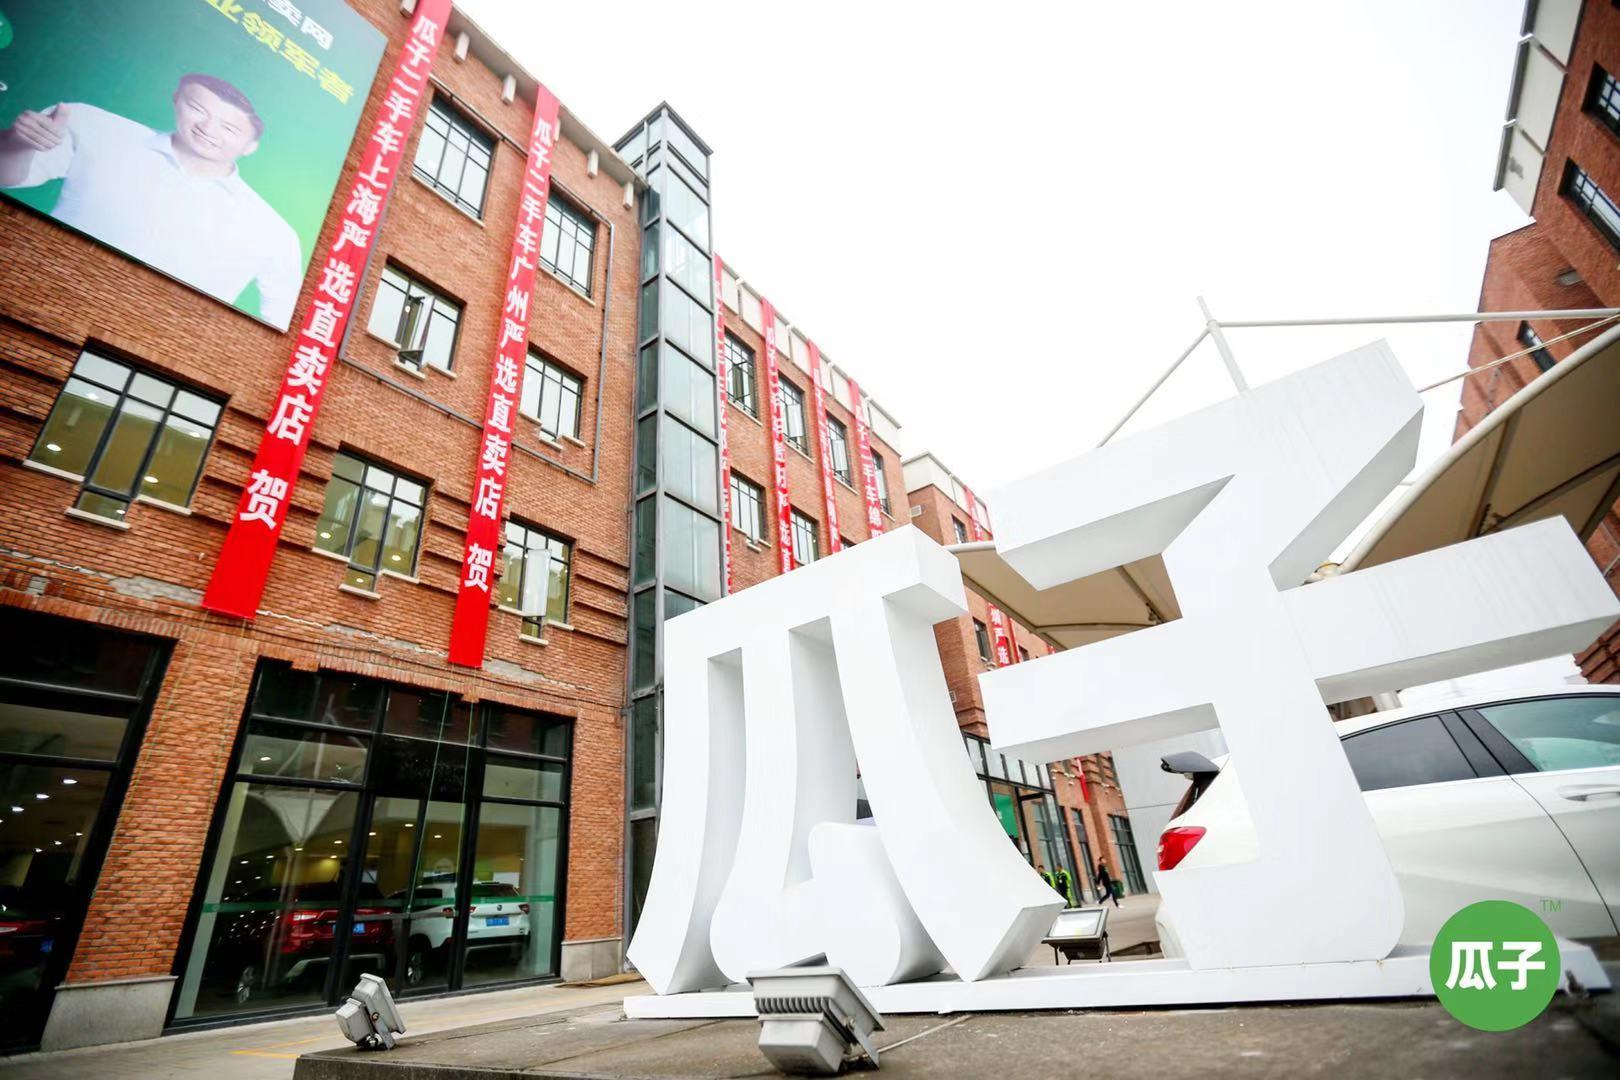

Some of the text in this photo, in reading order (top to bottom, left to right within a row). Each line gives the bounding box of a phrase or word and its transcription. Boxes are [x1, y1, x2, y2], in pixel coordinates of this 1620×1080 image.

[239, 15, 439, 531] 瓜子二手车上海严选直卖店 贺
[464, 118, 553, 592] 瓜子二手车广州严选直卖店 贺
